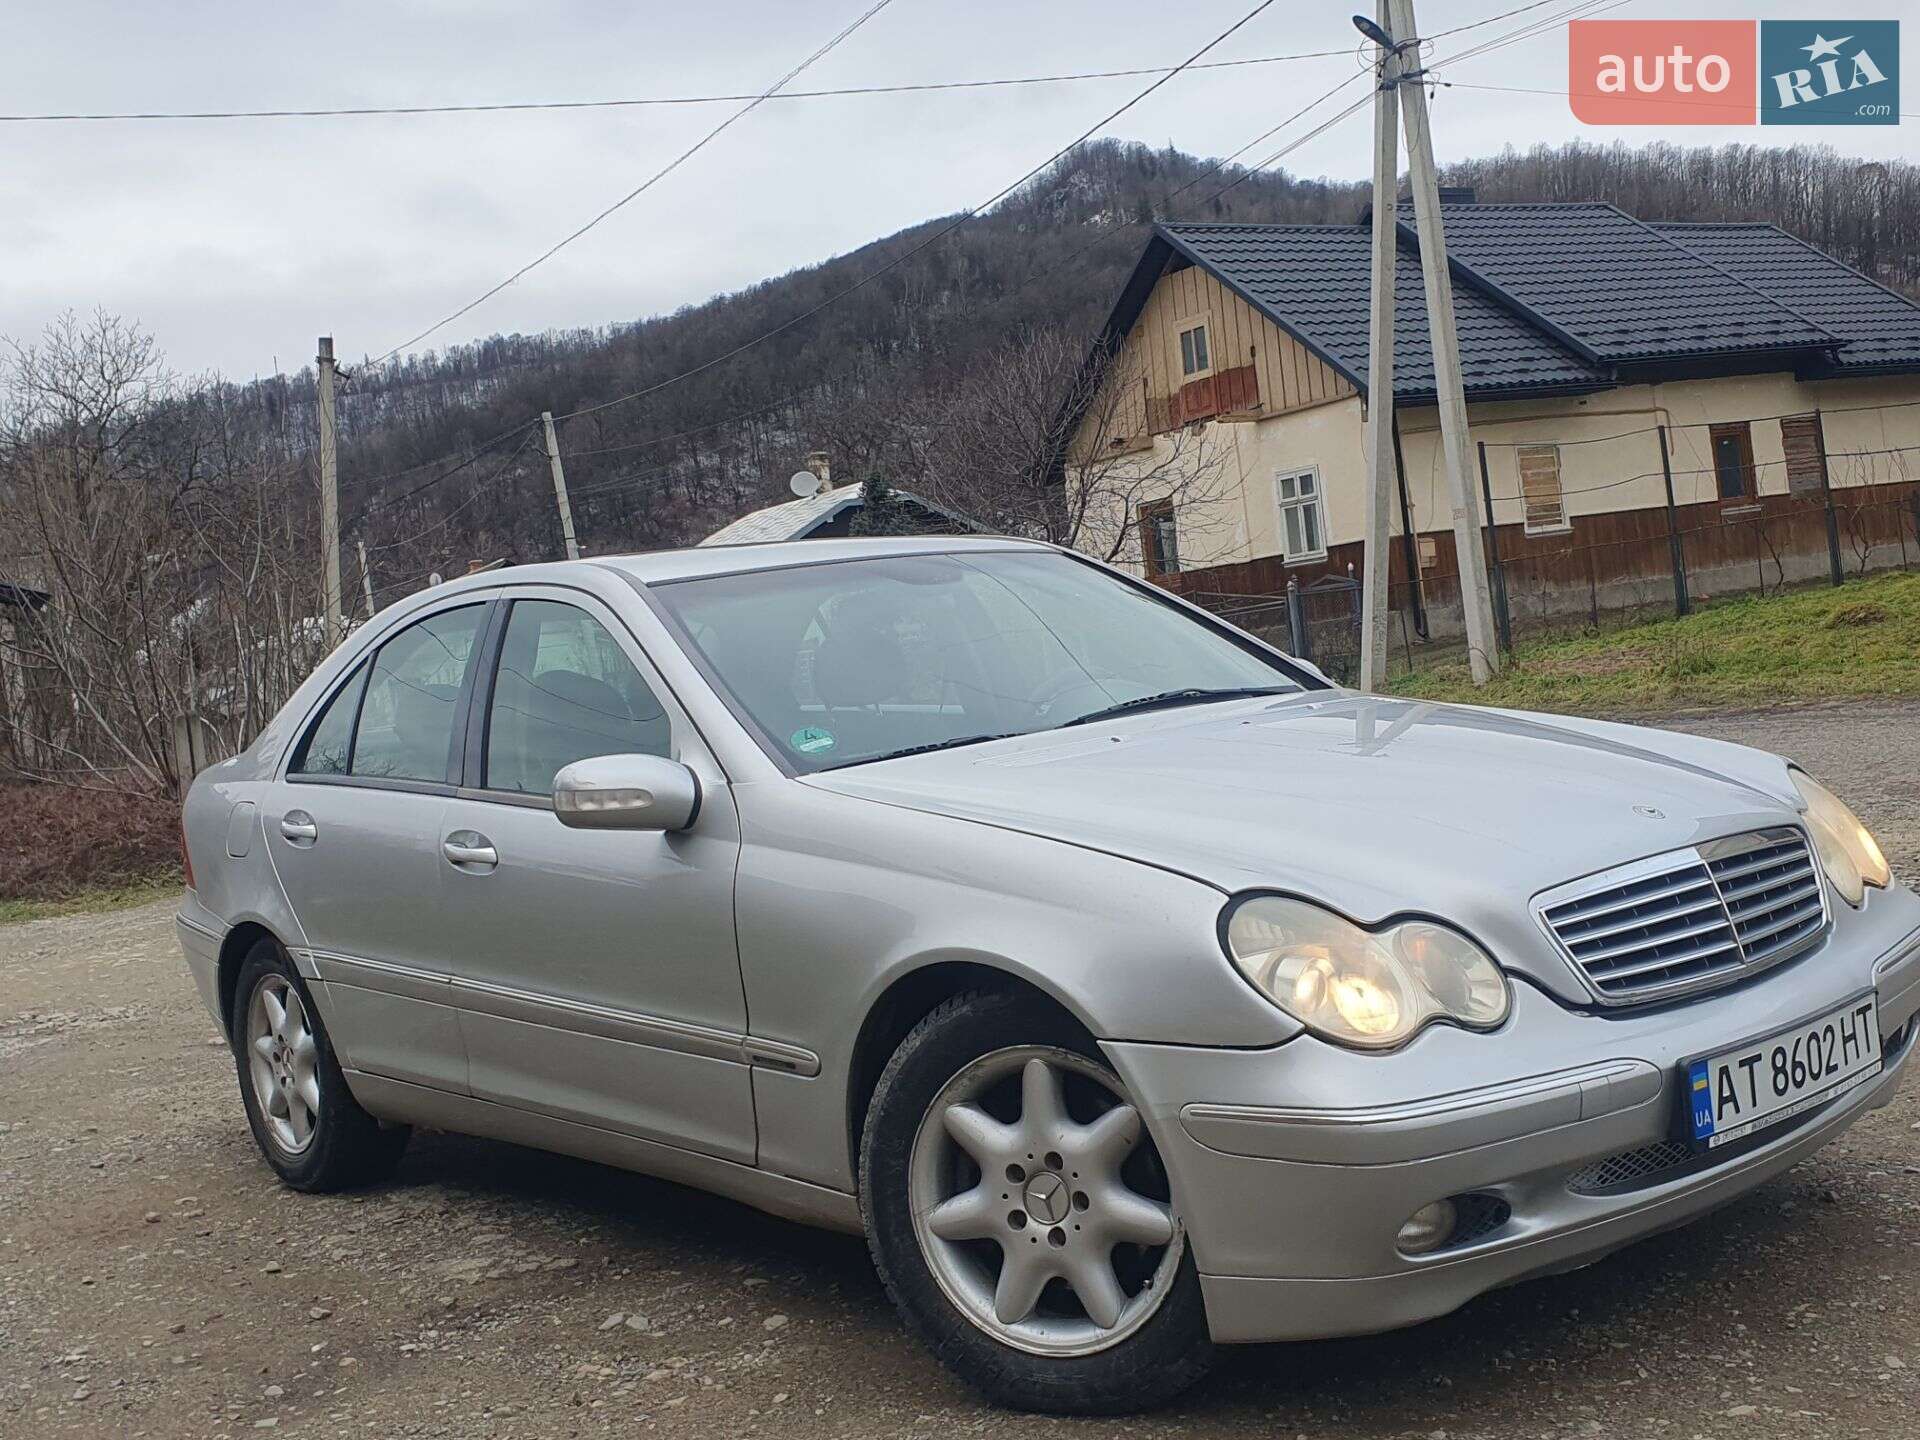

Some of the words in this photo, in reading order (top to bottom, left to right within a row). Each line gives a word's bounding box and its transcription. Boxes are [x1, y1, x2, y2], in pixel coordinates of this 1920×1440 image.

[1716, 1053, 1762, 1121] AT
[1770, 1024, 1838, 1097] 8602
[1840, 1003, 1872, 1065] HT
[1695, 1111, 1712, 1128] UA
